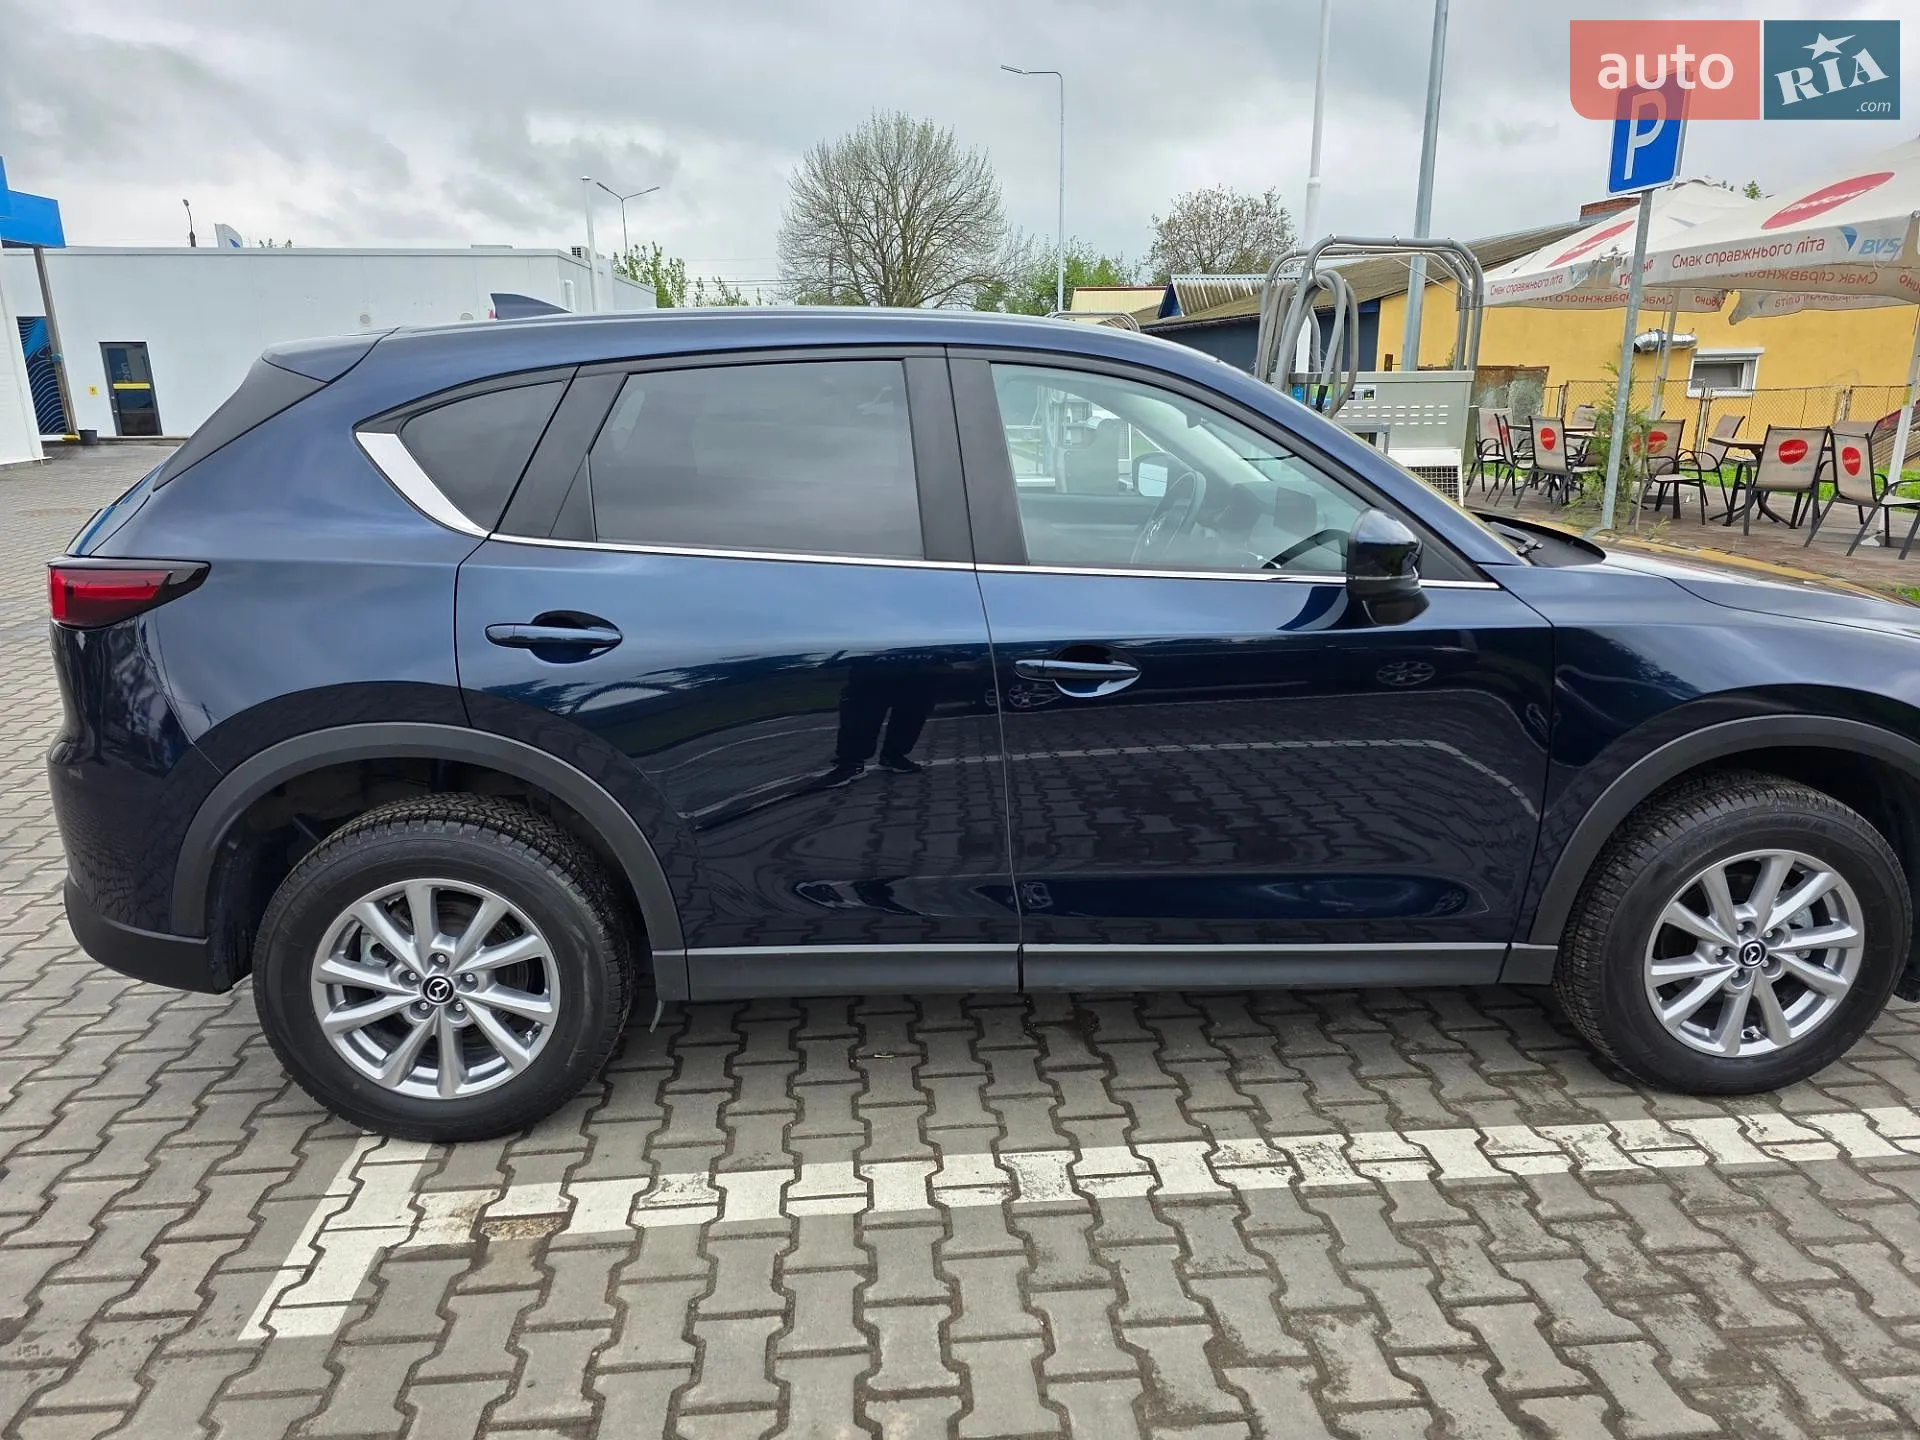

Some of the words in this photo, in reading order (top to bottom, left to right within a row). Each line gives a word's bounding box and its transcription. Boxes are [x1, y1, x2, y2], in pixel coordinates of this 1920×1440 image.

[1623, 90, 1667, 181] P
[1672, 253, 1702, 269] Смак
[1705, 243, 1792, 267] справжнього
[1796, 236, 1825, 255] літа
[1859, 237, 1902, 255] BVS
[1490, 284, 1505, 296] Смак
[1506, 278, 1549, 295] справжнього
